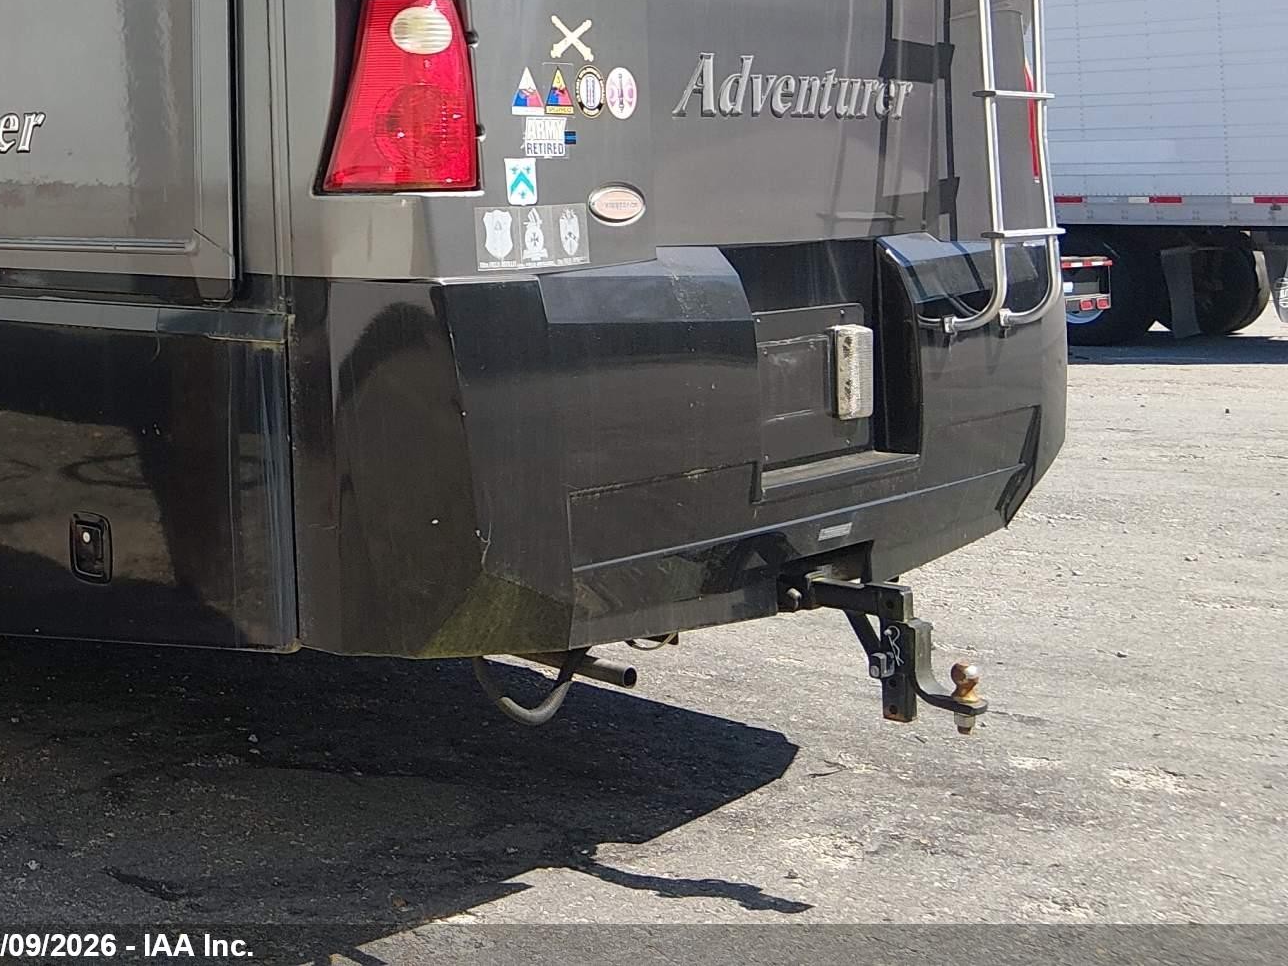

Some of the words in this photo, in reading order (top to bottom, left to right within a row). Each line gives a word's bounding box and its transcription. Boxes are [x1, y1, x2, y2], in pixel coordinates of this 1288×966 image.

[671, 51, 914, 120] Adventurer
[527, 118, 565, 140] ARMY
[526, 142, 564, 155] RETIRED
